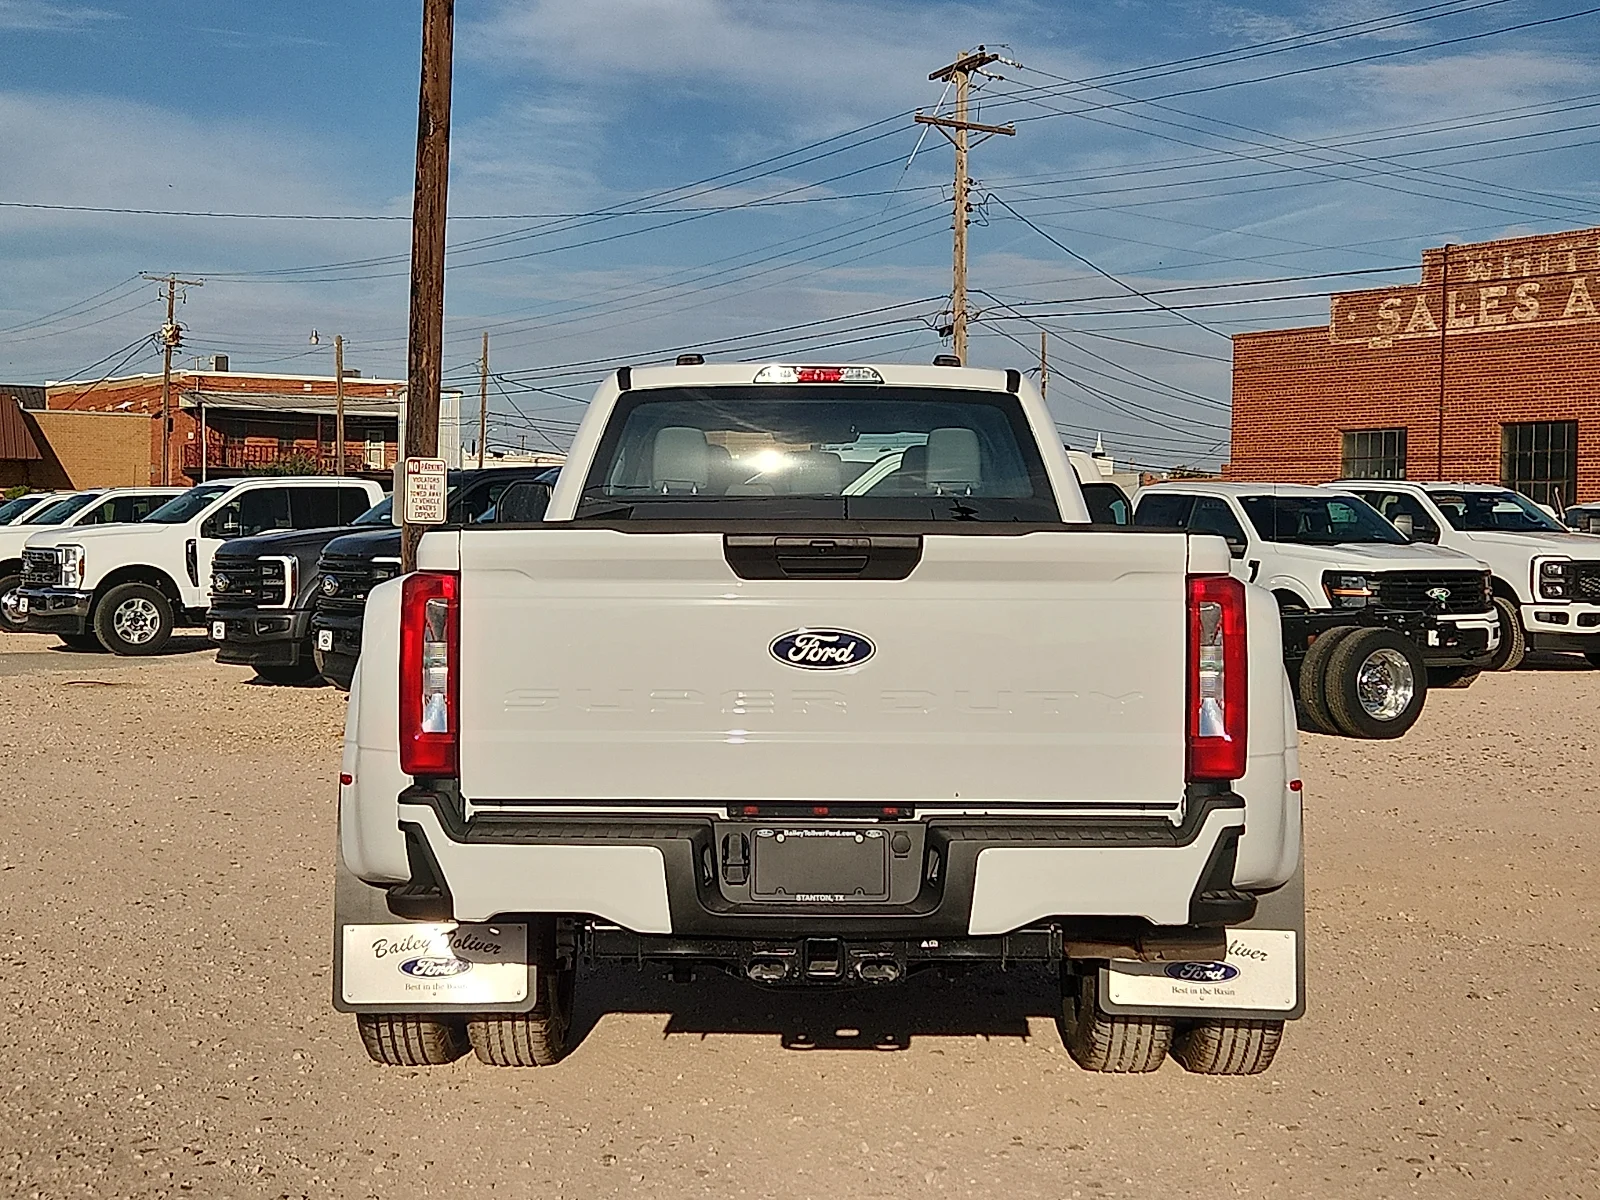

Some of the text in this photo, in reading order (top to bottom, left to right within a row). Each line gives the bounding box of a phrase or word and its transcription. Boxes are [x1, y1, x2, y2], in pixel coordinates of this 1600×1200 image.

[1376, 282, 1541, 334] SALES
[409, 461, 443, 472] NO PARKING
[783, 829, 857, 838] BaileyToliverFord.com
[834, 894, 845, 902] TX
[371, 934, 432, 959] Bailey
[405, 983, 421, 991] Best
[423, 983, 431, 991] in
[1171, 986, 1235, 996] Best in the Basin
